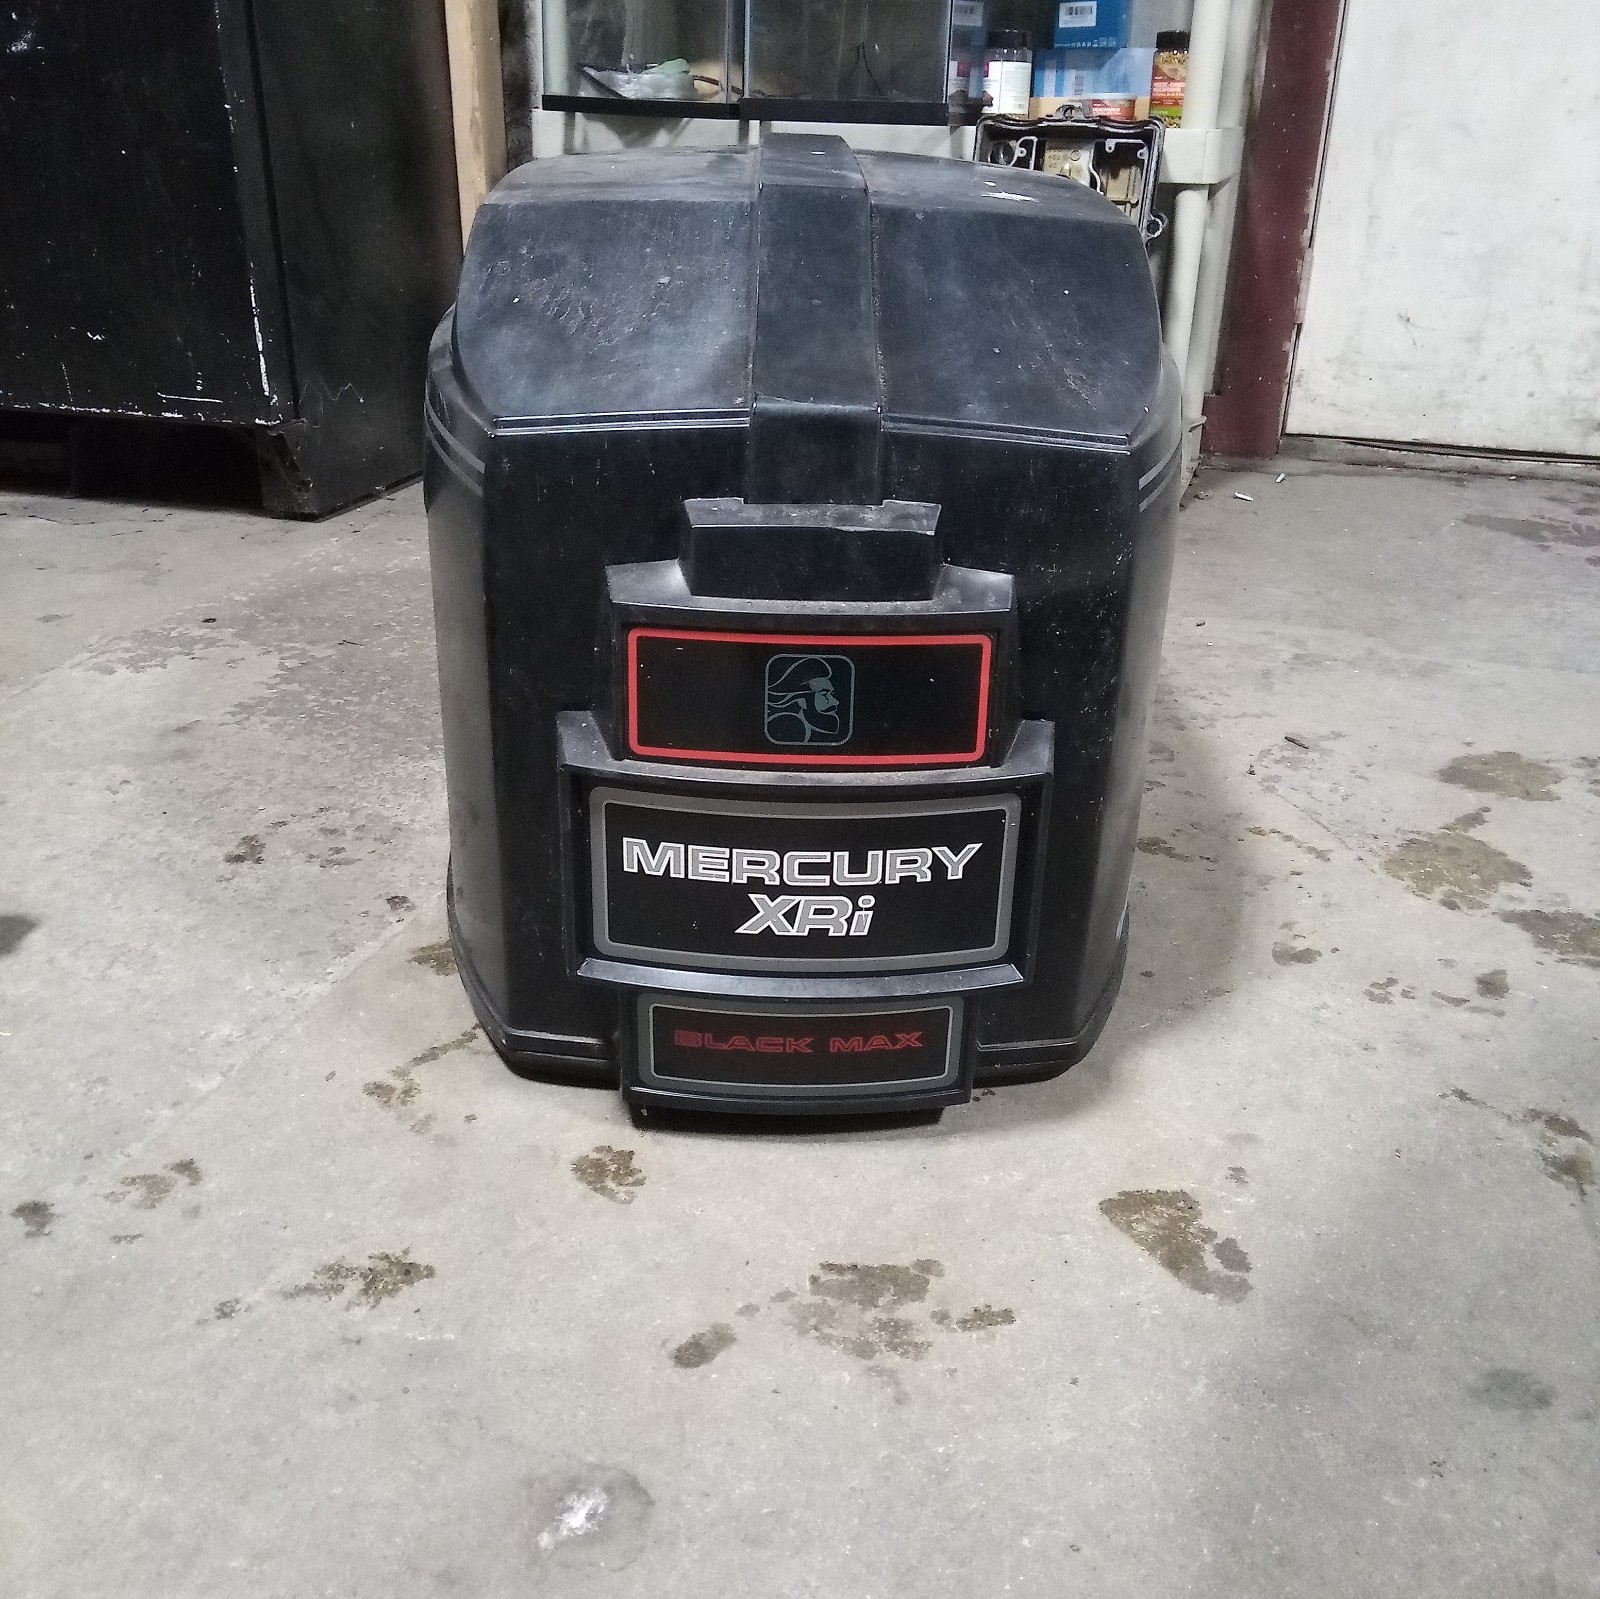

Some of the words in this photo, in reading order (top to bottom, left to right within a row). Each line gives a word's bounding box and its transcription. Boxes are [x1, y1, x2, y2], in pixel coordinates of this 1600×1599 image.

[622, 837, 983, 886] MERCURY
[735, 893, 876, 936] XRi
[674, 1030, 813, 1054] BLACK
[829, 1031, 923, 1053] MAX
